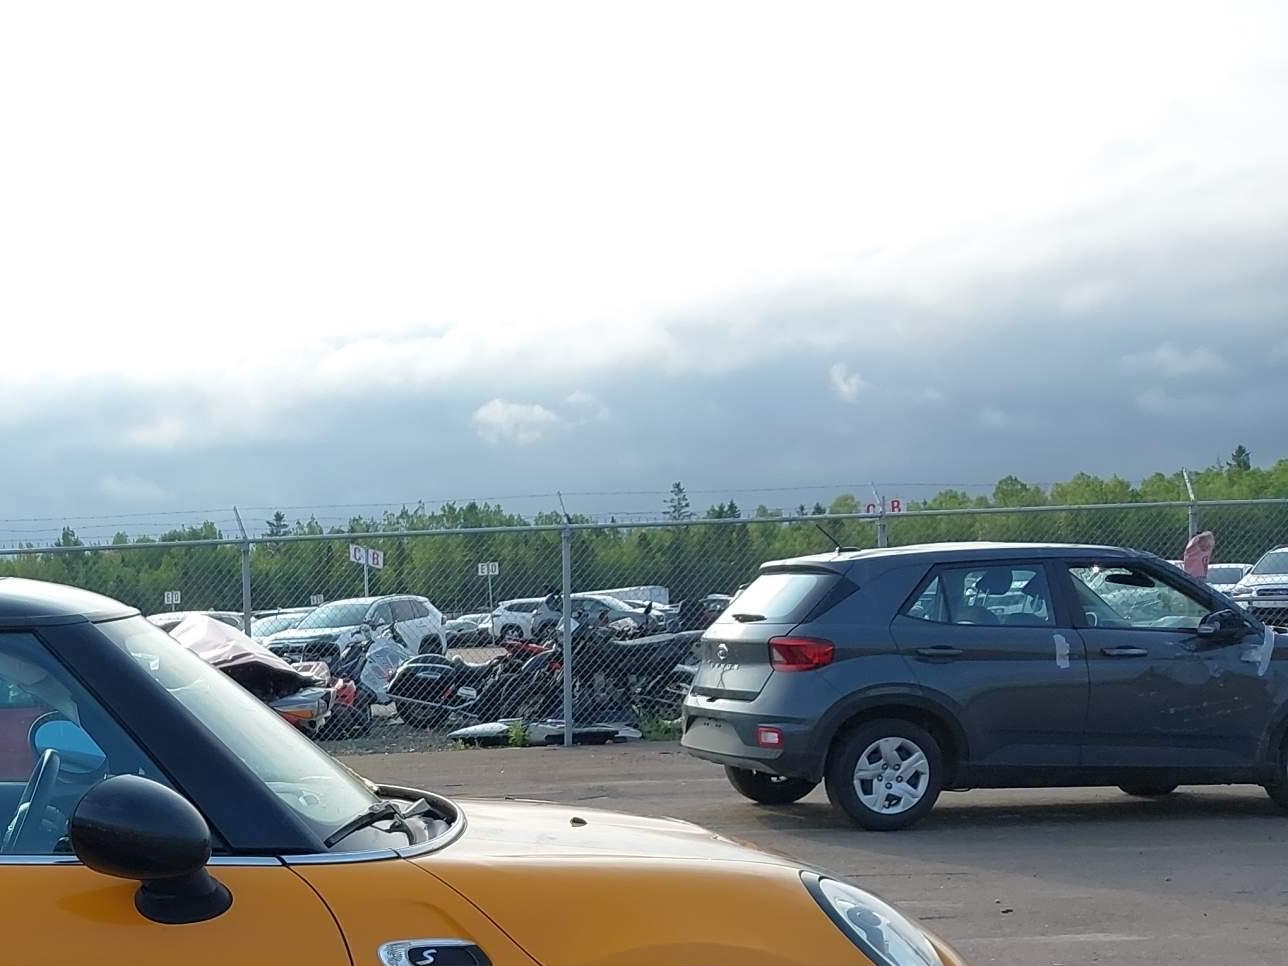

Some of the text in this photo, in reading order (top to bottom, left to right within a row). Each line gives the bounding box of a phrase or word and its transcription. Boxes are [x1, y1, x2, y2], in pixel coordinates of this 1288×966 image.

[353, 546, 380, 566] C B
[415, 948, 437, 966] S
